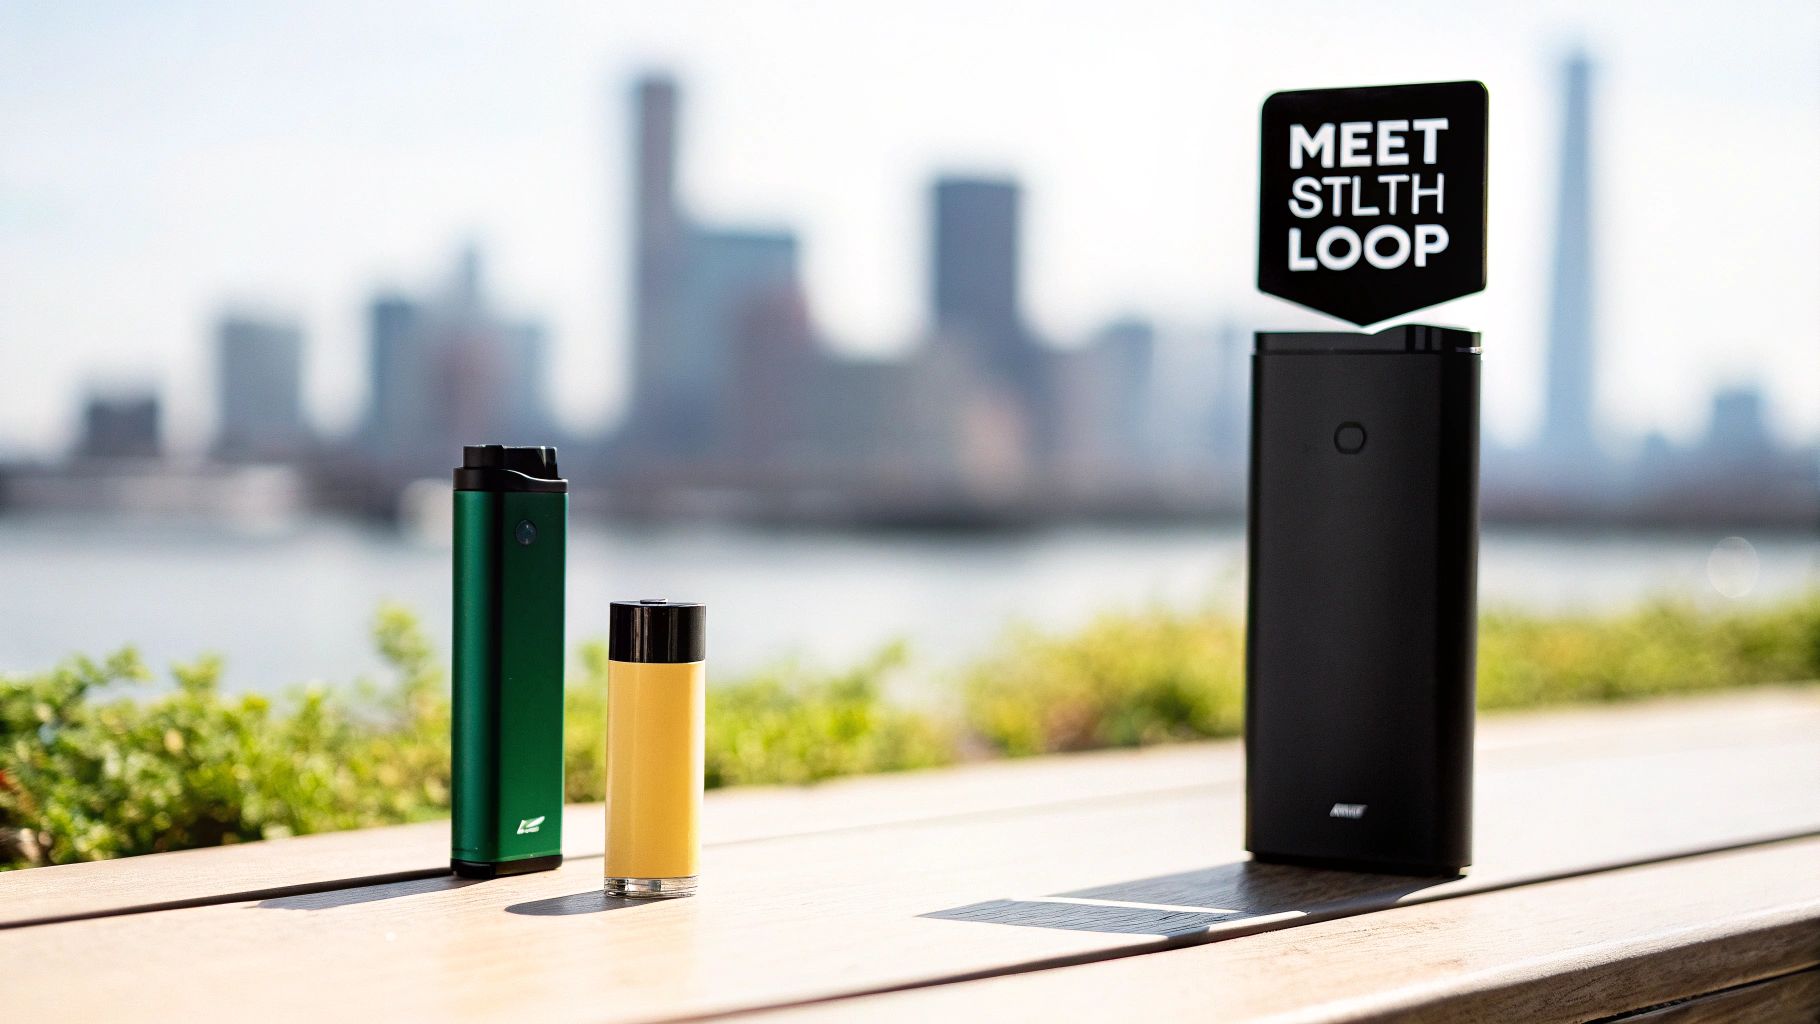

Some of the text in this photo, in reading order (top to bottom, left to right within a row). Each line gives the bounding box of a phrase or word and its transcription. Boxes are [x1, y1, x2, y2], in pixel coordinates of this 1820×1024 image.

[1289, 117, 1449, 169] MEET
[1288, 173, 1445, 218] STLTH
[1288, 224, 1450, 271] LOOP
